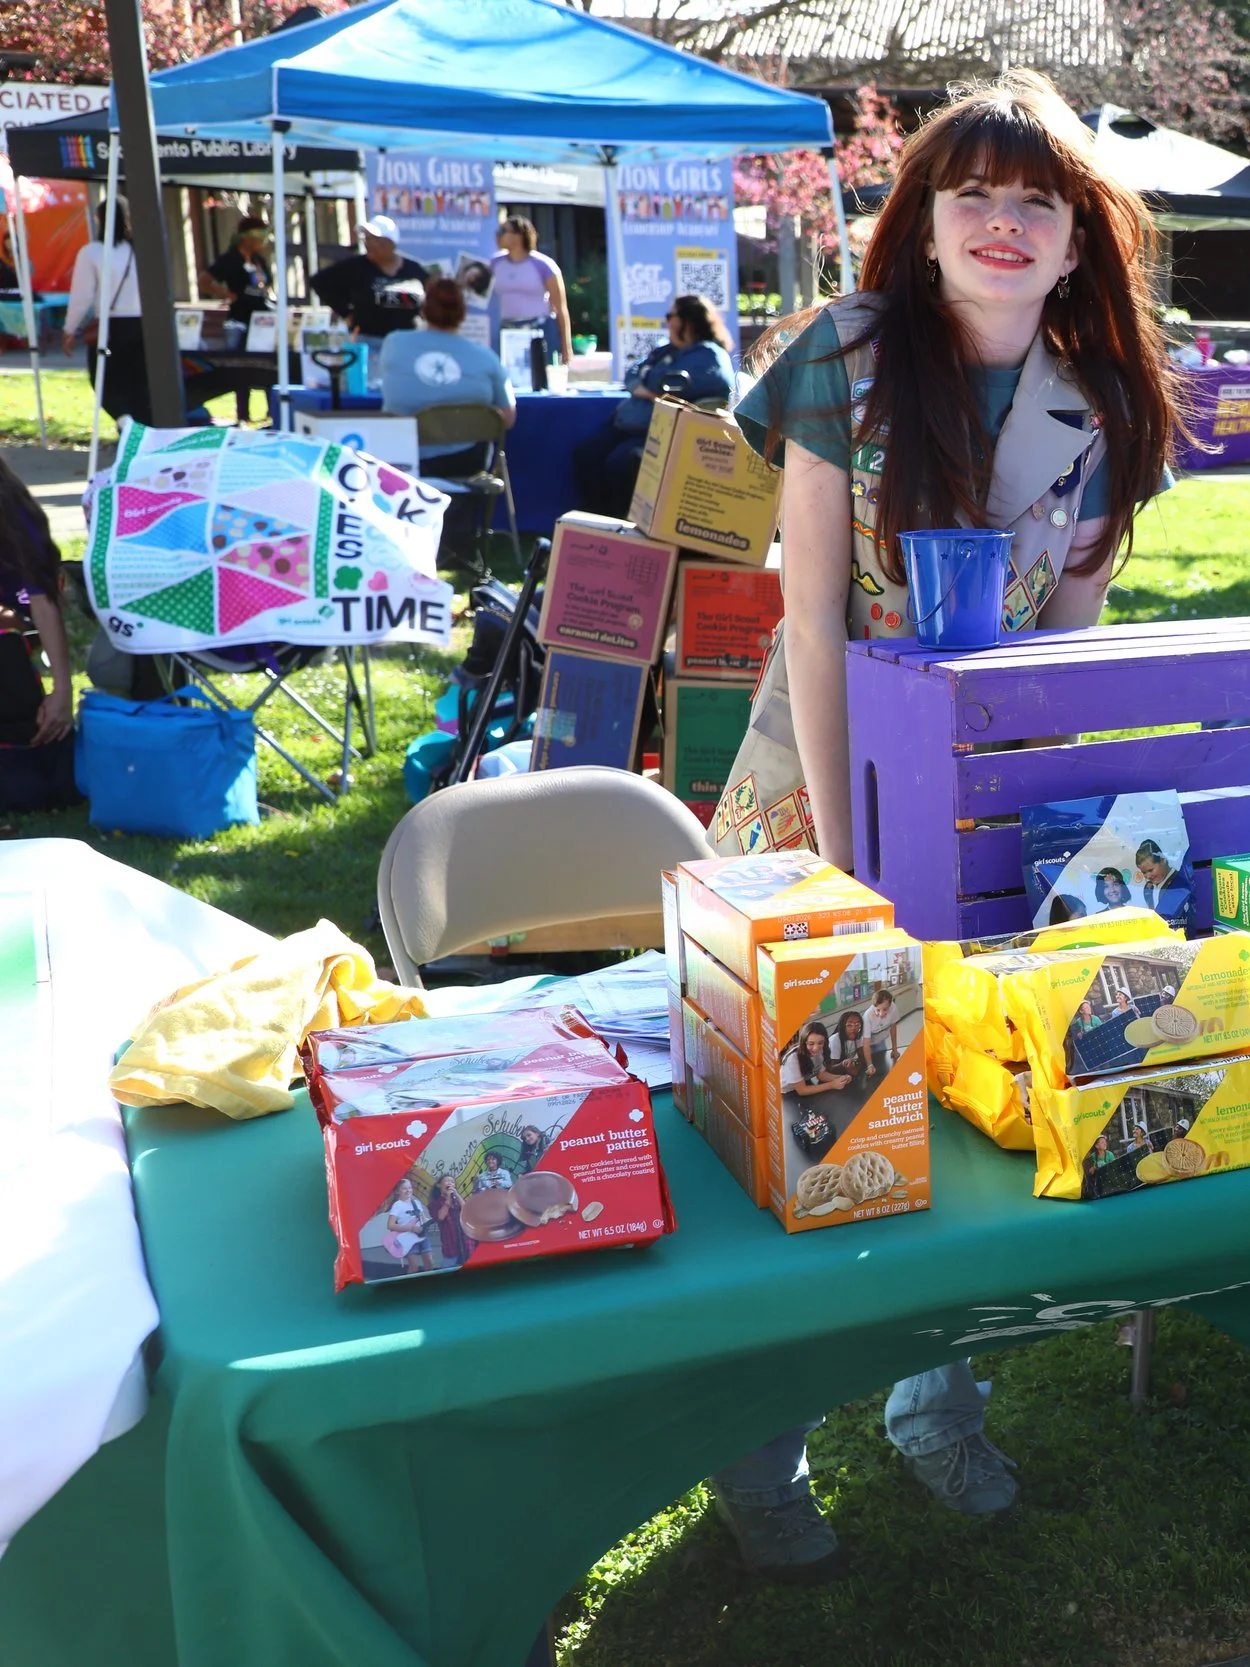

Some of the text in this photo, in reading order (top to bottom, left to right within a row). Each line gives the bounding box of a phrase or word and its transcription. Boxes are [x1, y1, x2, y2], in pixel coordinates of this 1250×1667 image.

[192, 142, 240, 159] Public
[427, 156, 485, 188] GIRLS
[666, 164, 722, 192] GIRLS
[677, 520, 748, 549] lemonades
[567, 592, 599, 606] Cookie
[332, 595, 445, 634] TIME
[108, 614, 134, 638] gs
[559, 625, 600, 641] caramel
[686, 657, 717, 667] peanut
[691, 781, 718, 793] thin
[1034, 856, 1066, 868] girl scouts
[783, 977, 824, 989] girl scouts
[1203, 1035, 1213, 1043] NET
[883, 1089, 923, 1108] peanut
[888, 1101, 924, 1115] butter
[1083, 1110, 1106, 1119] scouts
[868, 1111, 924, 1130] sandwich
[355, 1138, 411, 1156] girl scouts
[560, 1128, 648, 1151] peanut butter
[847, 1142, 870, 1151] cookies
[850, 1133, 866, 1144] Crisp
[866, 1133, 878, 1142] and
[892, 1142, 909, 1150] butter
[569, 1162, 590, 1173] Crispy
[590, 1159, 614, 1168] cookies
[614, 1156, 637, 1166] layered
[573, 1169, 596, 1179] peanut
[596, 1166, 616, 1175] butter
[629, 1160, 654, 1169] covered
[853, 1209, 865, 1218] NET
[866, 1208, 875, 1216] WT
[882, 1205, 891, 1213] OZ
[892, 1201, 910, 1213] (227g)
[578, 1221, 648, 1239] NET WT 6.5 OZ (184g)
